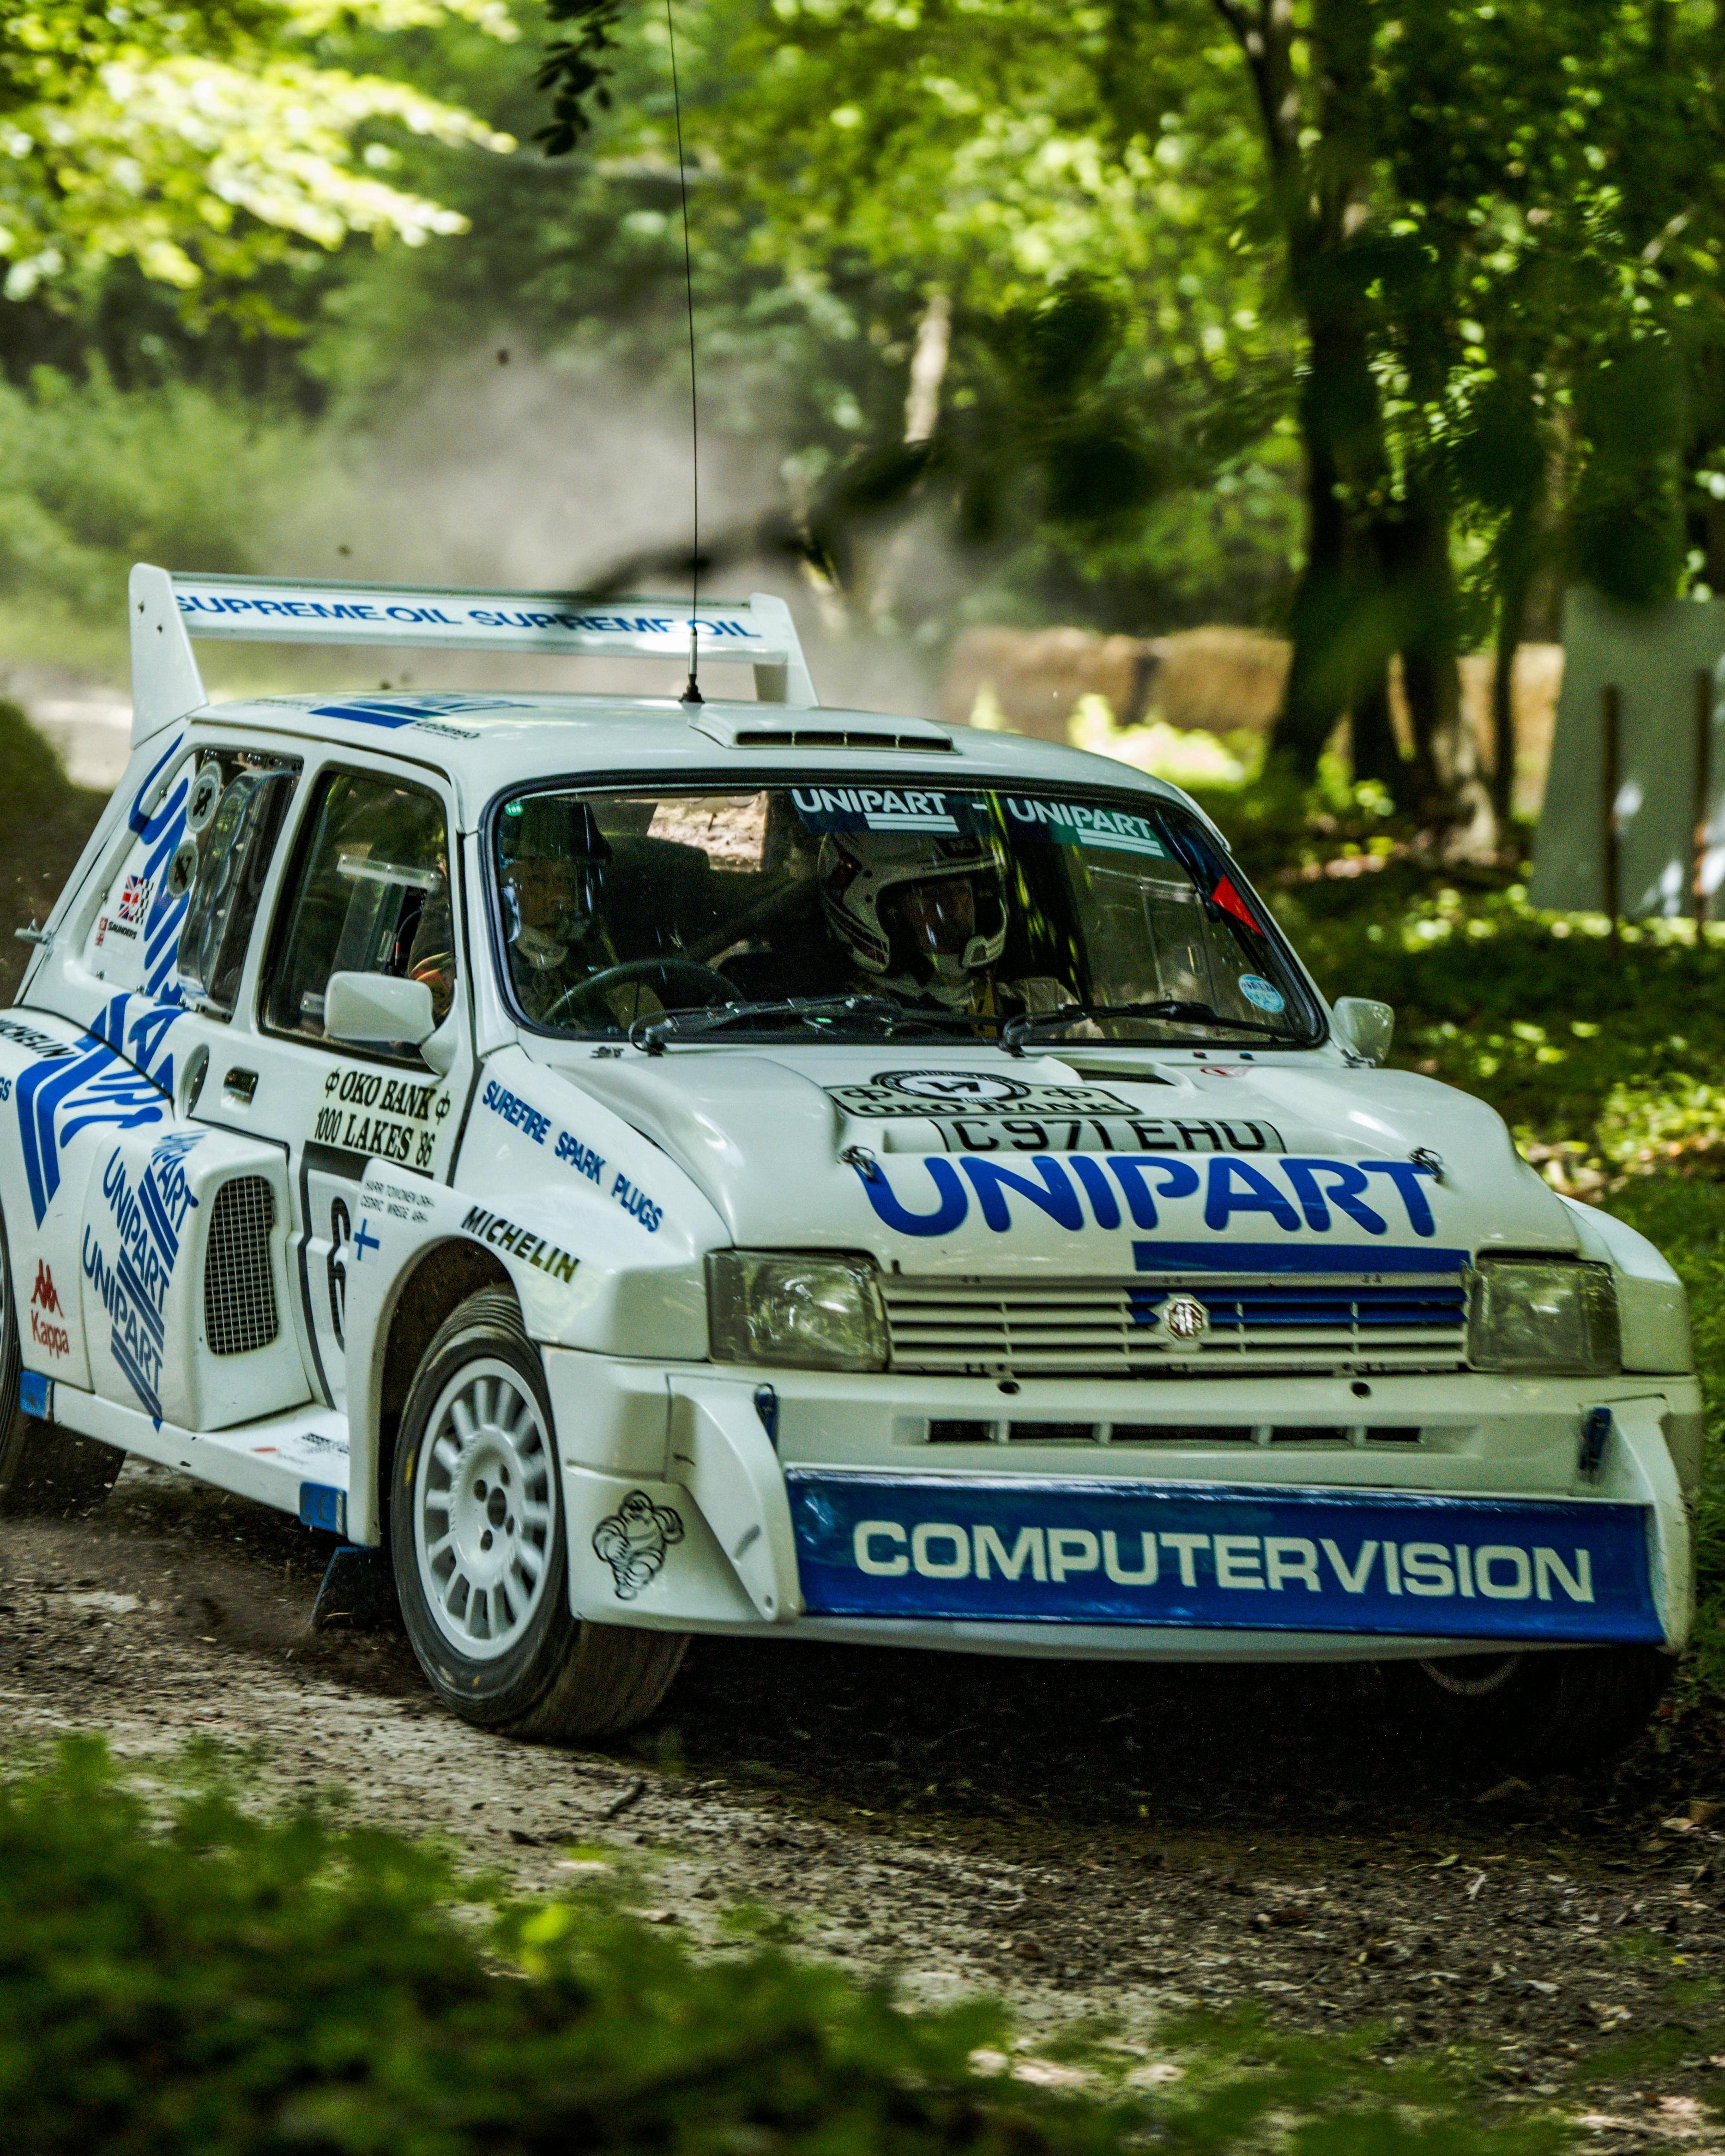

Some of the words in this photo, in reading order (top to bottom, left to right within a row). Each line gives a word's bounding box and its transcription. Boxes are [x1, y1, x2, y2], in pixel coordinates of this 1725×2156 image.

[176, 595, 386, 621] SUPREME
[386, 607, 463, 625] OIL
[468, 610, 676, 633] SUPREME
[686, 620, 763, 638] OIL
[791, 788, 947, 816] UNIPART
[1007, 797, 1152, 840] UNIPART
[107, 921, 138, 940] SAUNDERS
[0, 1019, 75, 1058] ICHELIN
[338, 1071, 382, 1107] OKO
[378, 1079, 437, 1121] BANK
[858, 1103, 967, 1114] OKO
[972, 1102, 1118, 1114] BANK
[314, 1106, 343, 1144] 1000
[342, 1112, 415, 1161] LAKES
[482, 1079, 552, 1145] SUREFIRE
[554, 1131, 606, 1186] SPARK
[611, 1171, 663, 1233] PLUGS
[951, 1120, 1115, 1151] C971
[1125, 1120, 1266, 1151] EHU
[852, 1156, 1436, 1238] UNIPART
[103, 1145, 170, 1314] UNIPART
[462, 1204, 582, 1284] MICHELIN
[82, 1223, 163, 1395] UNIPART
[30, 1309, 70, 1360] Kappa
[852, 1519, 1597, 1603] COMPUTERVISION
